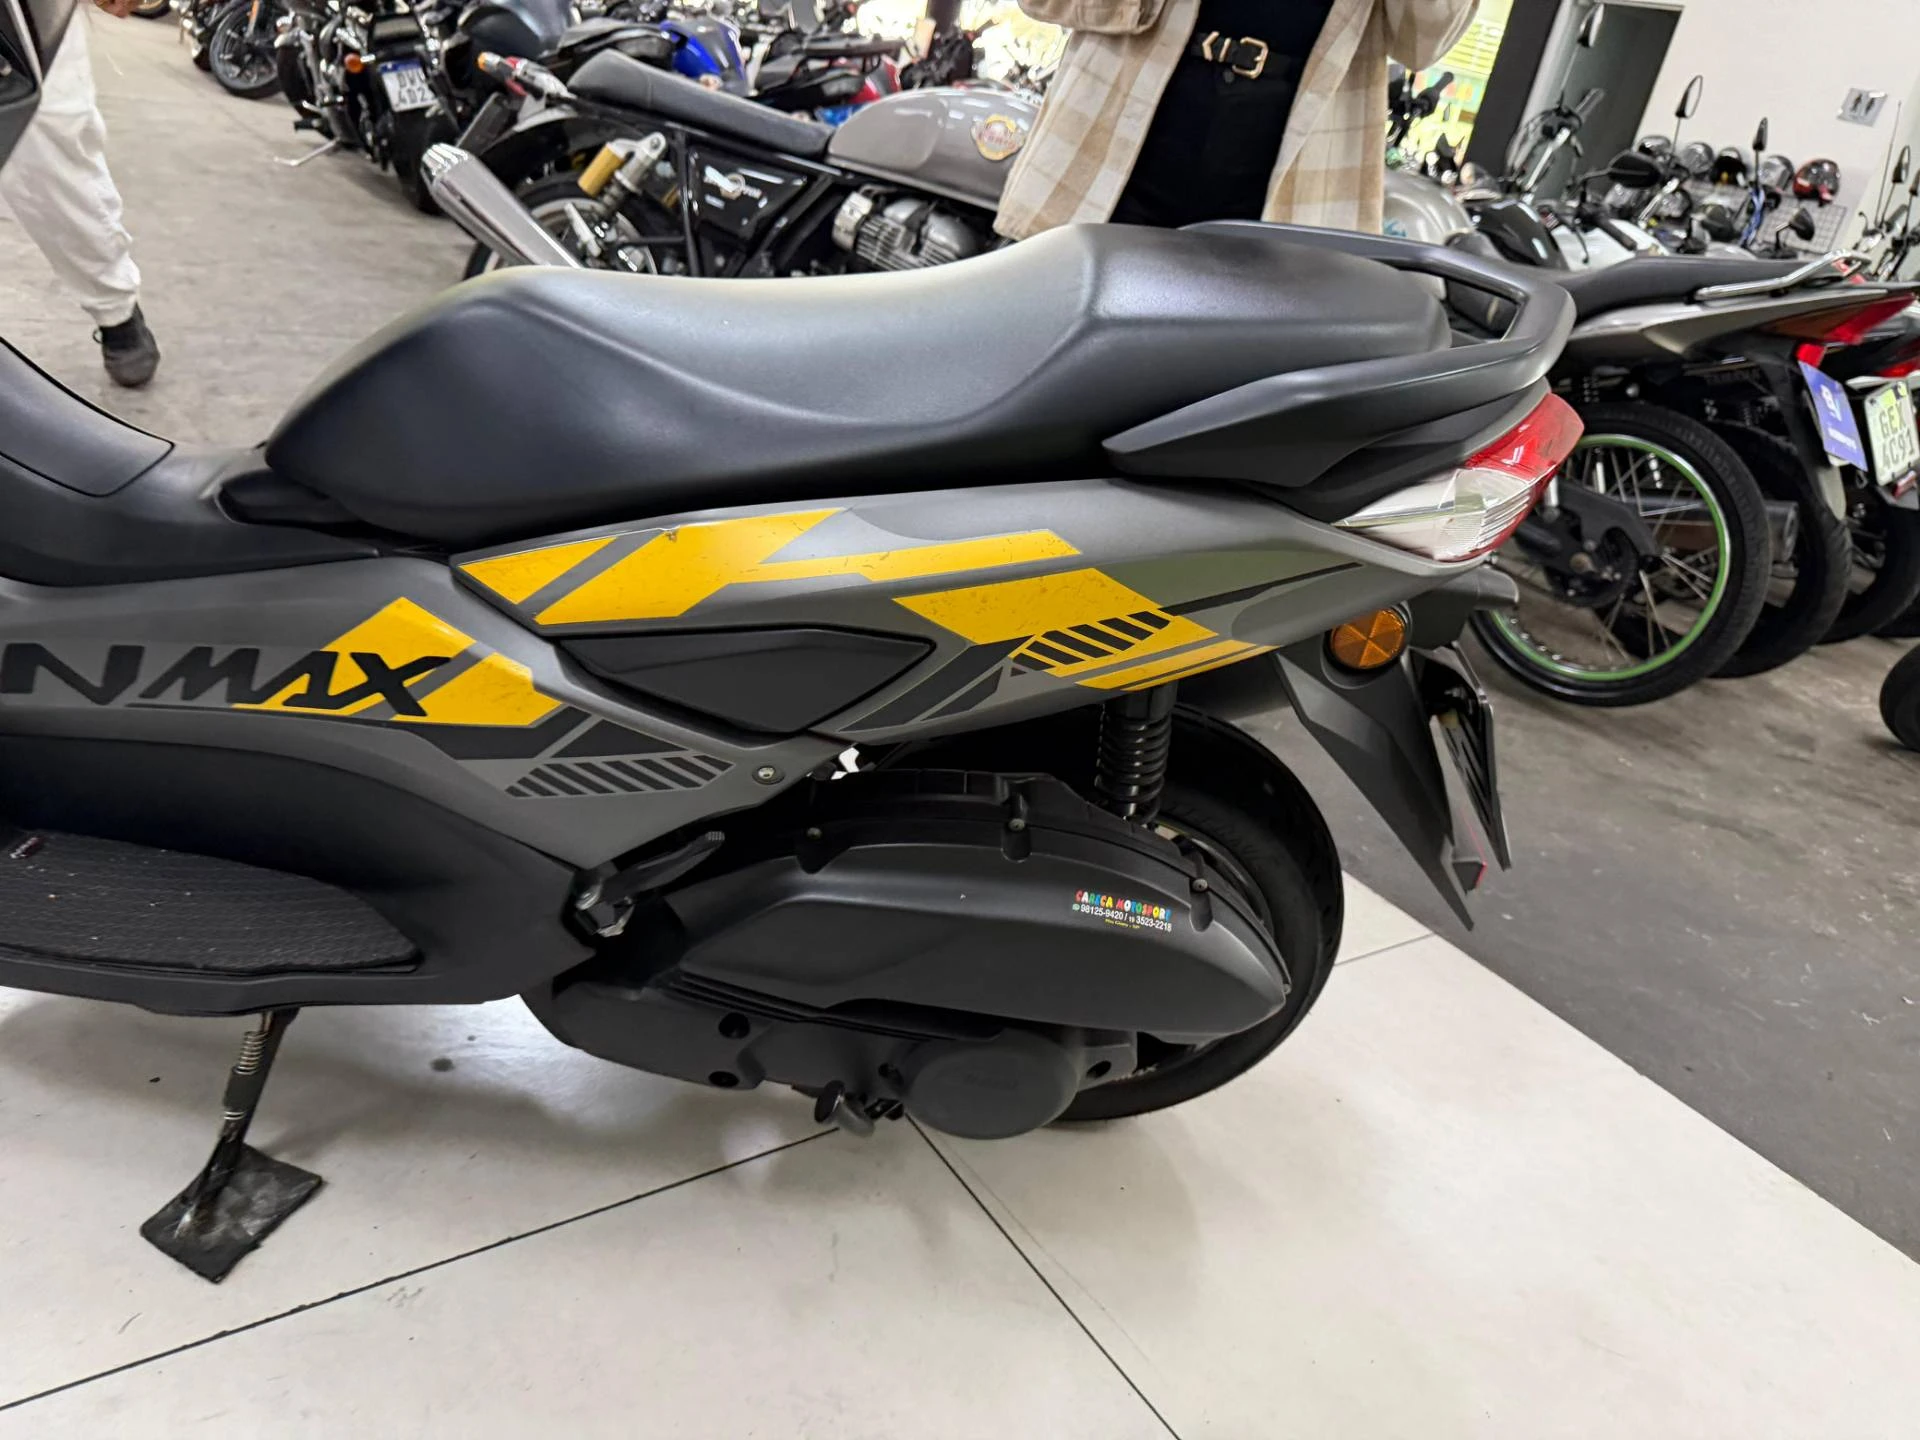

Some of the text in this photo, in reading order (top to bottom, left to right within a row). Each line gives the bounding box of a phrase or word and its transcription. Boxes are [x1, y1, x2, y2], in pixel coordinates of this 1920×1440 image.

[1879, 404, 1907, 438] GEX
[1881, 430, 1914, 469] 4C91
[2, 644, 450, 714] NMAX
[1116, 898, 1172, 921] MOTOSPORT
